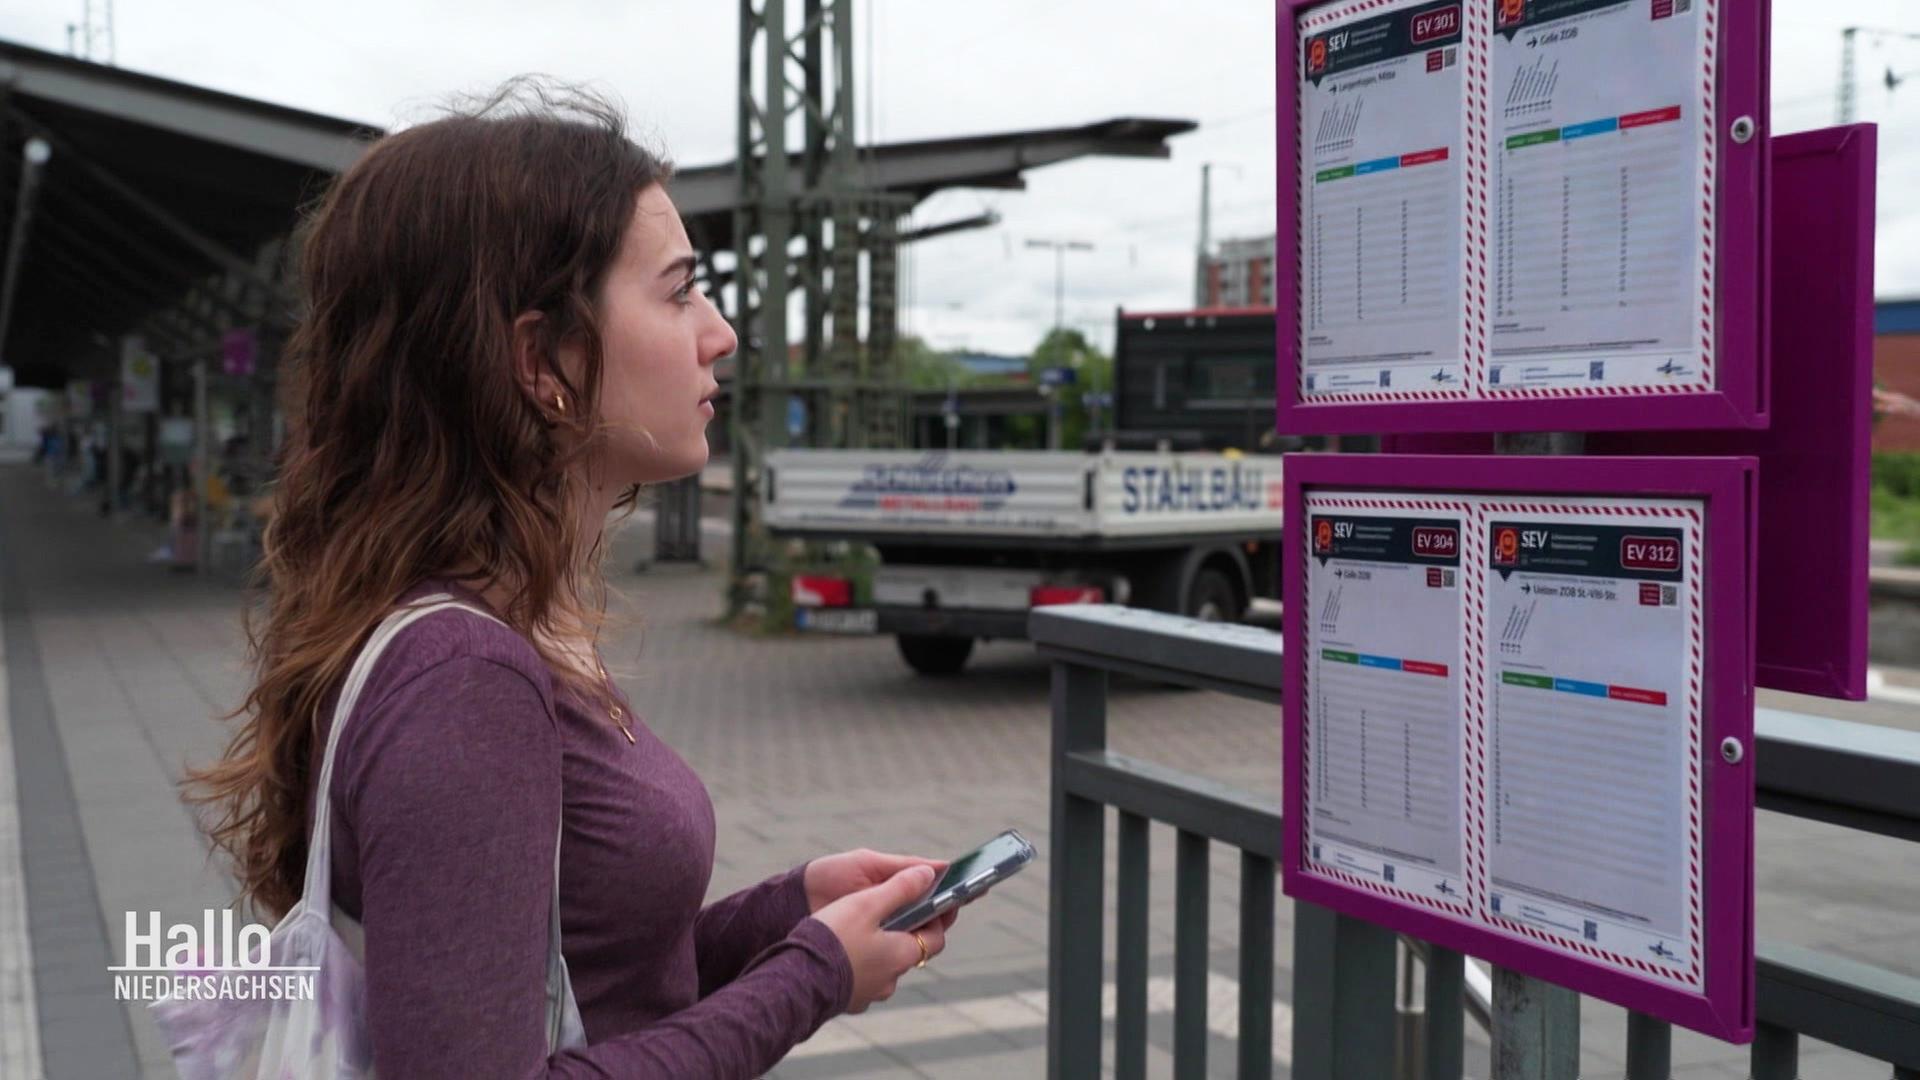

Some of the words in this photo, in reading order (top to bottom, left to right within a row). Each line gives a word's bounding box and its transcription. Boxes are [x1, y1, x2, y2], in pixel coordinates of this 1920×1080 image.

[1417, 20, 1434, 35] EV
[1434, 13, 1455, 31] 301
[1328, 31, 1349, 53] SEV
[1123, 465, 1263, 513] STAHLBAU
[1334, 522, 1354, 538] SEV
[1521, 530, 1548, 549] SEV
[1417, 534, 1432, 548] EV
[1433, 535, 1454, 549] 304
[1627, 544, 1647, 561] EV
[1648, 545, 1675, 563] 312
